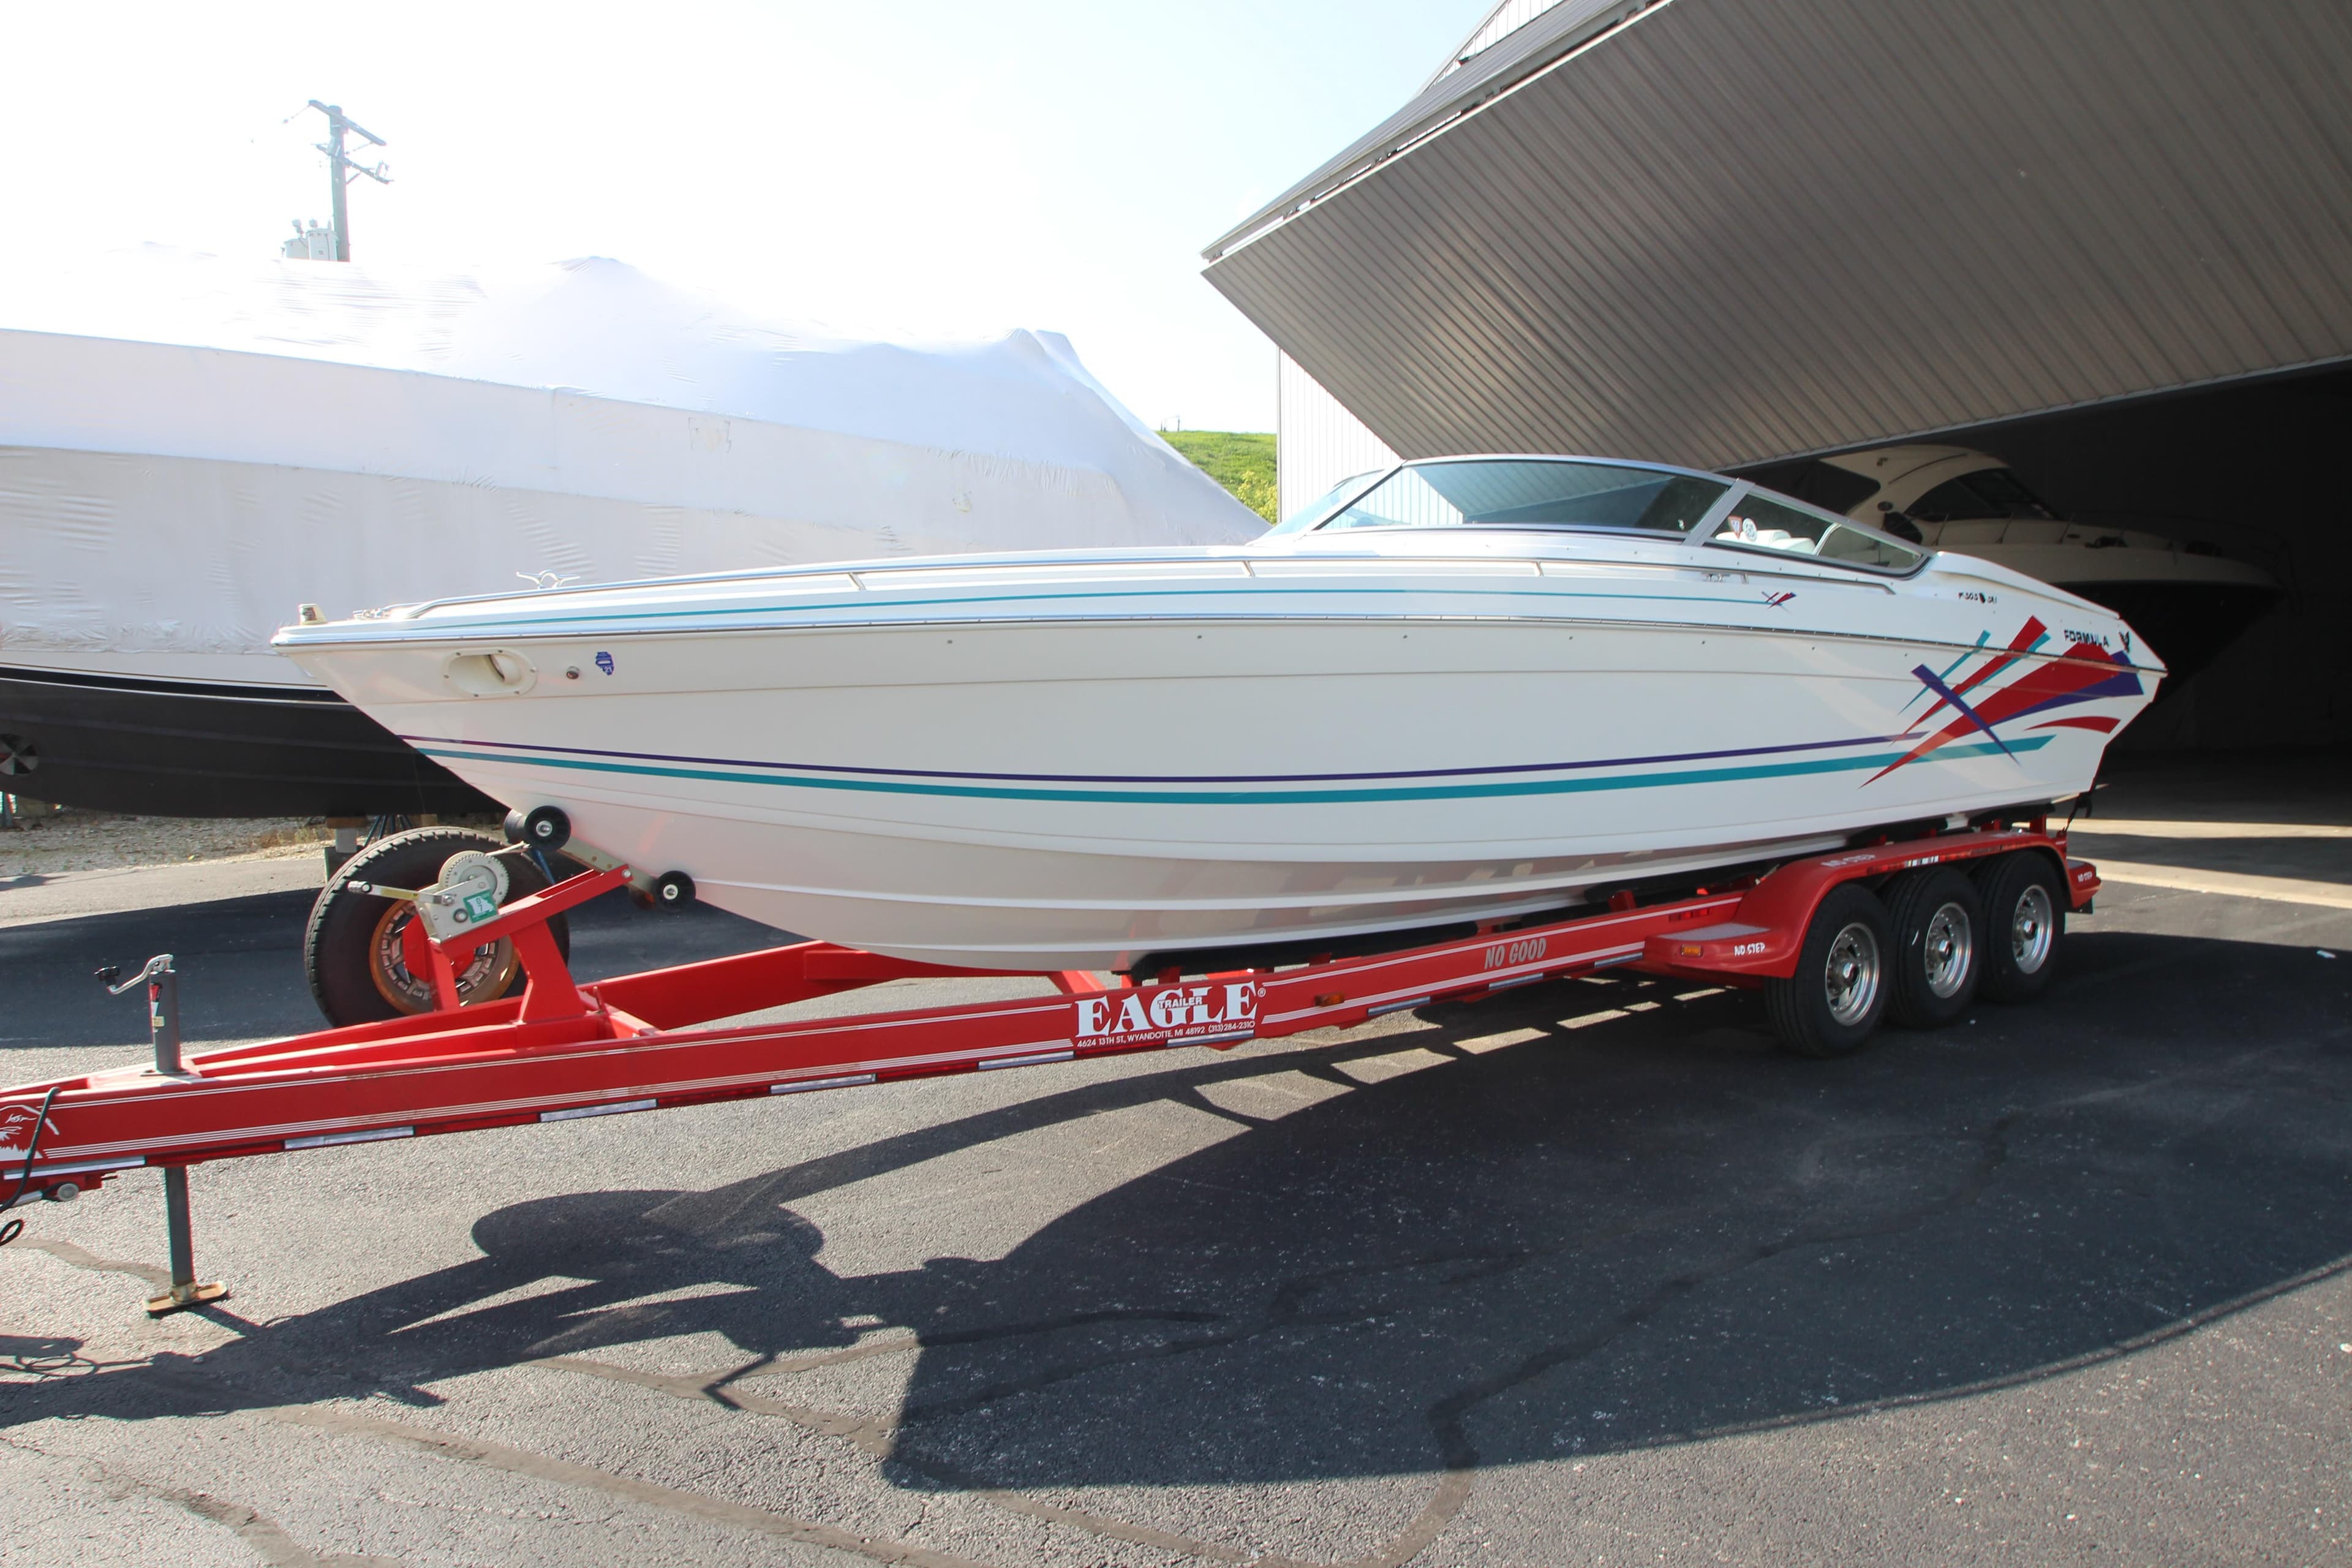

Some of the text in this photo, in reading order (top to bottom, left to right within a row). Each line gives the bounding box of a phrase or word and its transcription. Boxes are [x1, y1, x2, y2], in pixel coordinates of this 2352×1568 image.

[2064, 630, 2109, 647] FORMULA
[1484, 938, 1547, 970] NO GOOD
[1734, 941, 1765, 957] NO STEP
[1075, 980, 1257, 1038] EAGLE
[1158, 996, 1202, 1009] TRAILER
[1077, 1038, 1097, 1048] 4624
[1098, 1036, 1115, 1046] 13TH
[1127, 1030, 1174, 1042] WYANDOTTE,
[1174, 1028, 1183, 1037] MI
[1185, 1025, 1205, 1036] 48192
